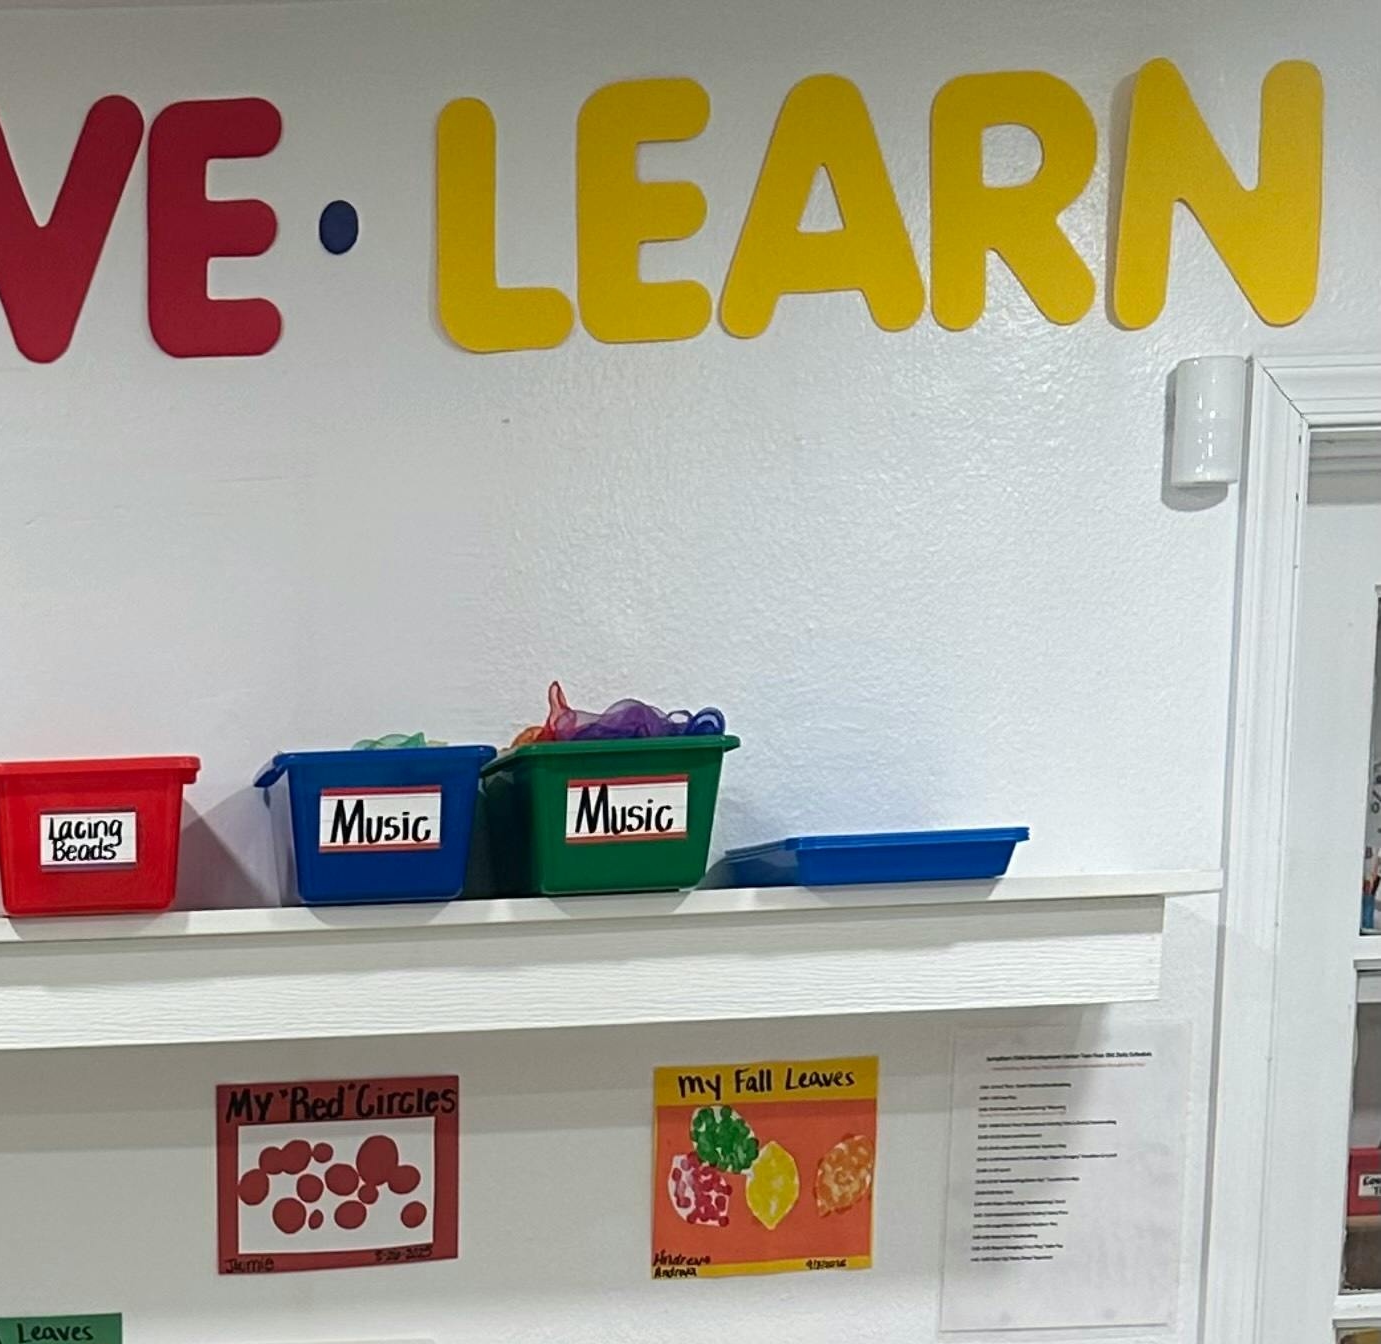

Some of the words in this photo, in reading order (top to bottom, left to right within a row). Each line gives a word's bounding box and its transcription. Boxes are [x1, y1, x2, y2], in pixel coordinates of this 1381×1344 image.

[435, 57, 1324, 353] LEARN
[329, 799, 432, 845] Music
[574, 784, 675, 835] Music
[48, 816, 123, 846] Lacing
[51, 837, 117, 862] Beads
[734, 1068, 773, 1094] Fall
[785, 1068, 855, 1091] Leaves
[356, 1083, 458, 1119] Circles
[17, 1323, 93, 1344] Leaves
